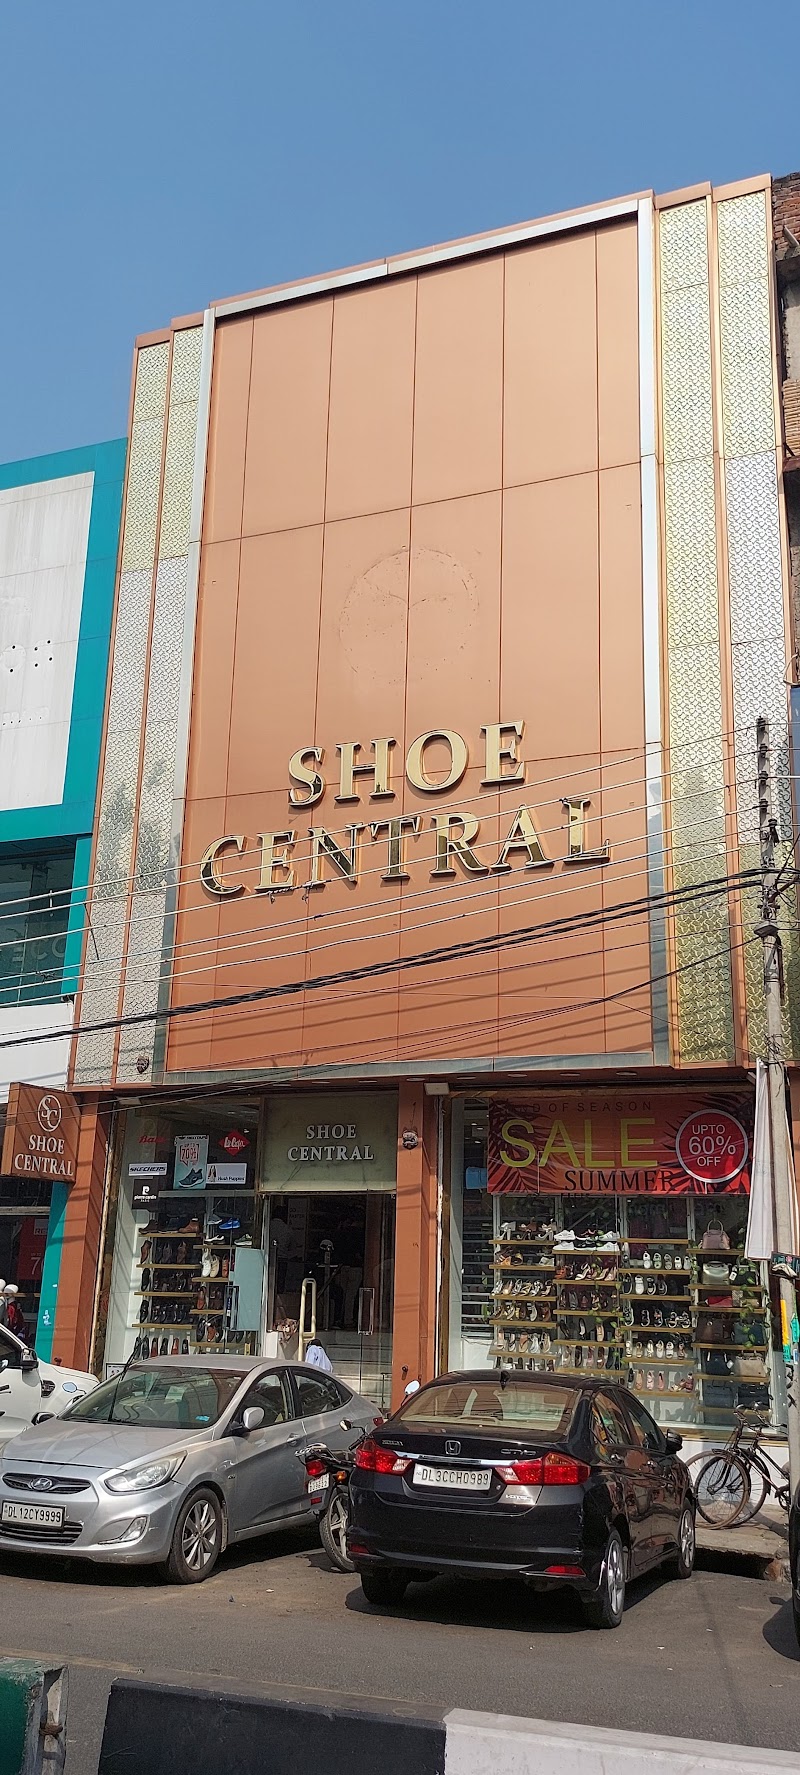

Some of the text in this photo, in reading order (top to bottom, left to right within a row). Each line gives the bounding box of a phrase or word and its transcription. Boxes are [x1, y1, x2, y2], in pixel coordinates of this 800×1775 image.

[288, 720, 527, 808] SHOE
[200, 797, 612, 896] CENTRAL
[549, 1102, 569, 1112] OF
[577, 1101, 651, 1112] SEASON
[306, 1124, 357, 1139] SHOE
[692, 1124, 726, 1135] UPTO
[28, 1134, 65, 1155] SHOE
[500, 1117, 658, 1168] SALE
[688, 1135, 736, 1155] 60%
[287, 1145, 374, 1161] CENTRAL
[697, 1156, 721, 1166] OFF
[14, 1153, 74, 1176] CENTRAL
[564, 1170, 677, 1192] SUMMER
